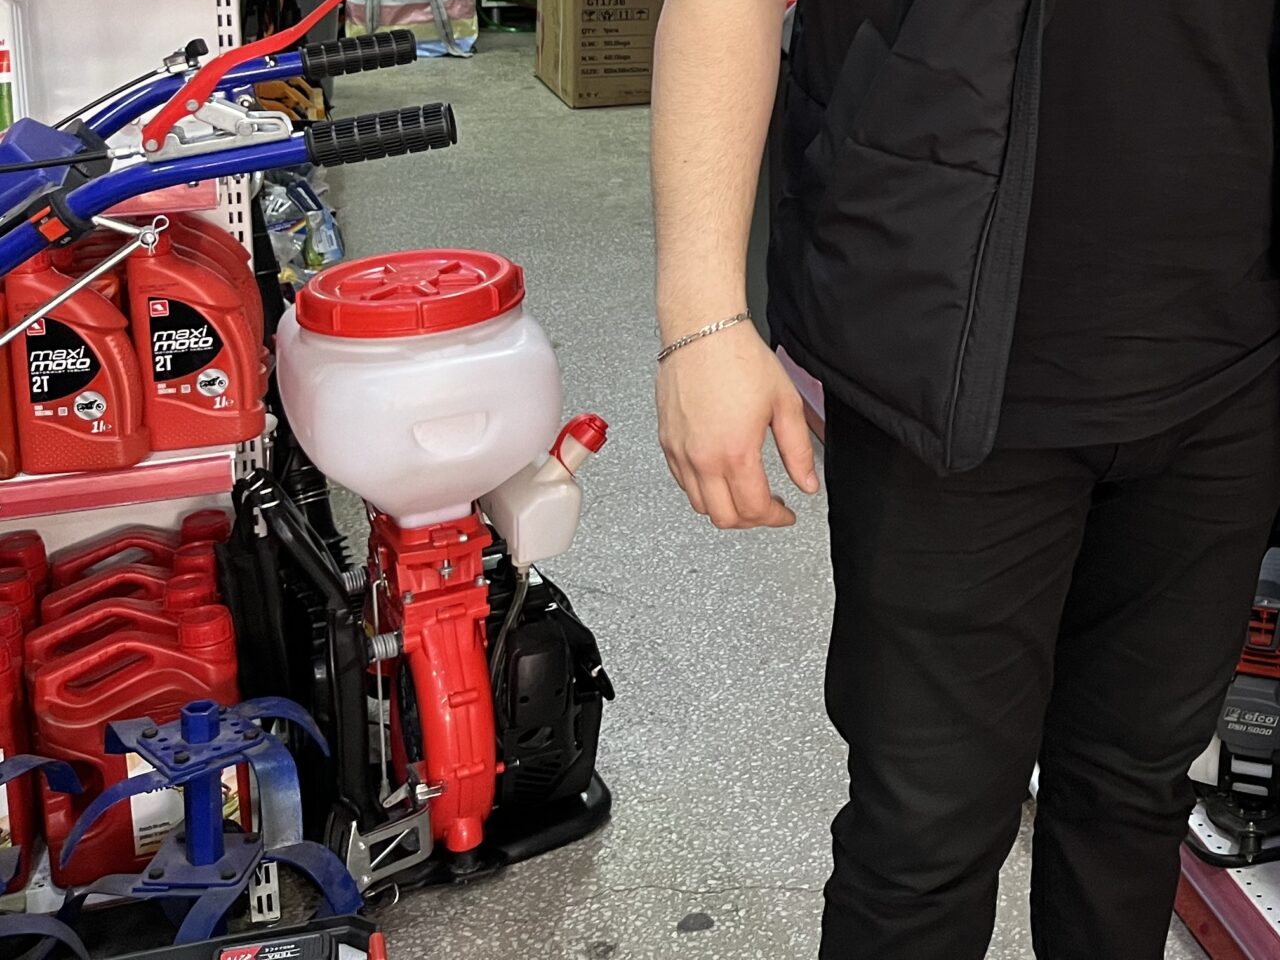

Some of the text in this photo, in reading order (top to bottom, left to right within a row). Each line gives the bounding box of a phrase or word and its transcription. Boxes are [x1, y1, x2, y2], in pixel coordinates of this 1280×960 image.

[153, 325, 207, 342] maxi
[154, 337, 213, 352] moto
[30, 345, 85, 361] maxi
[31, 358, 91, 372] moto
[155, 354, 173, 371] 2T
[32, 375, 50, 392] 2T
[1244, 712, 1275, 725] efco
